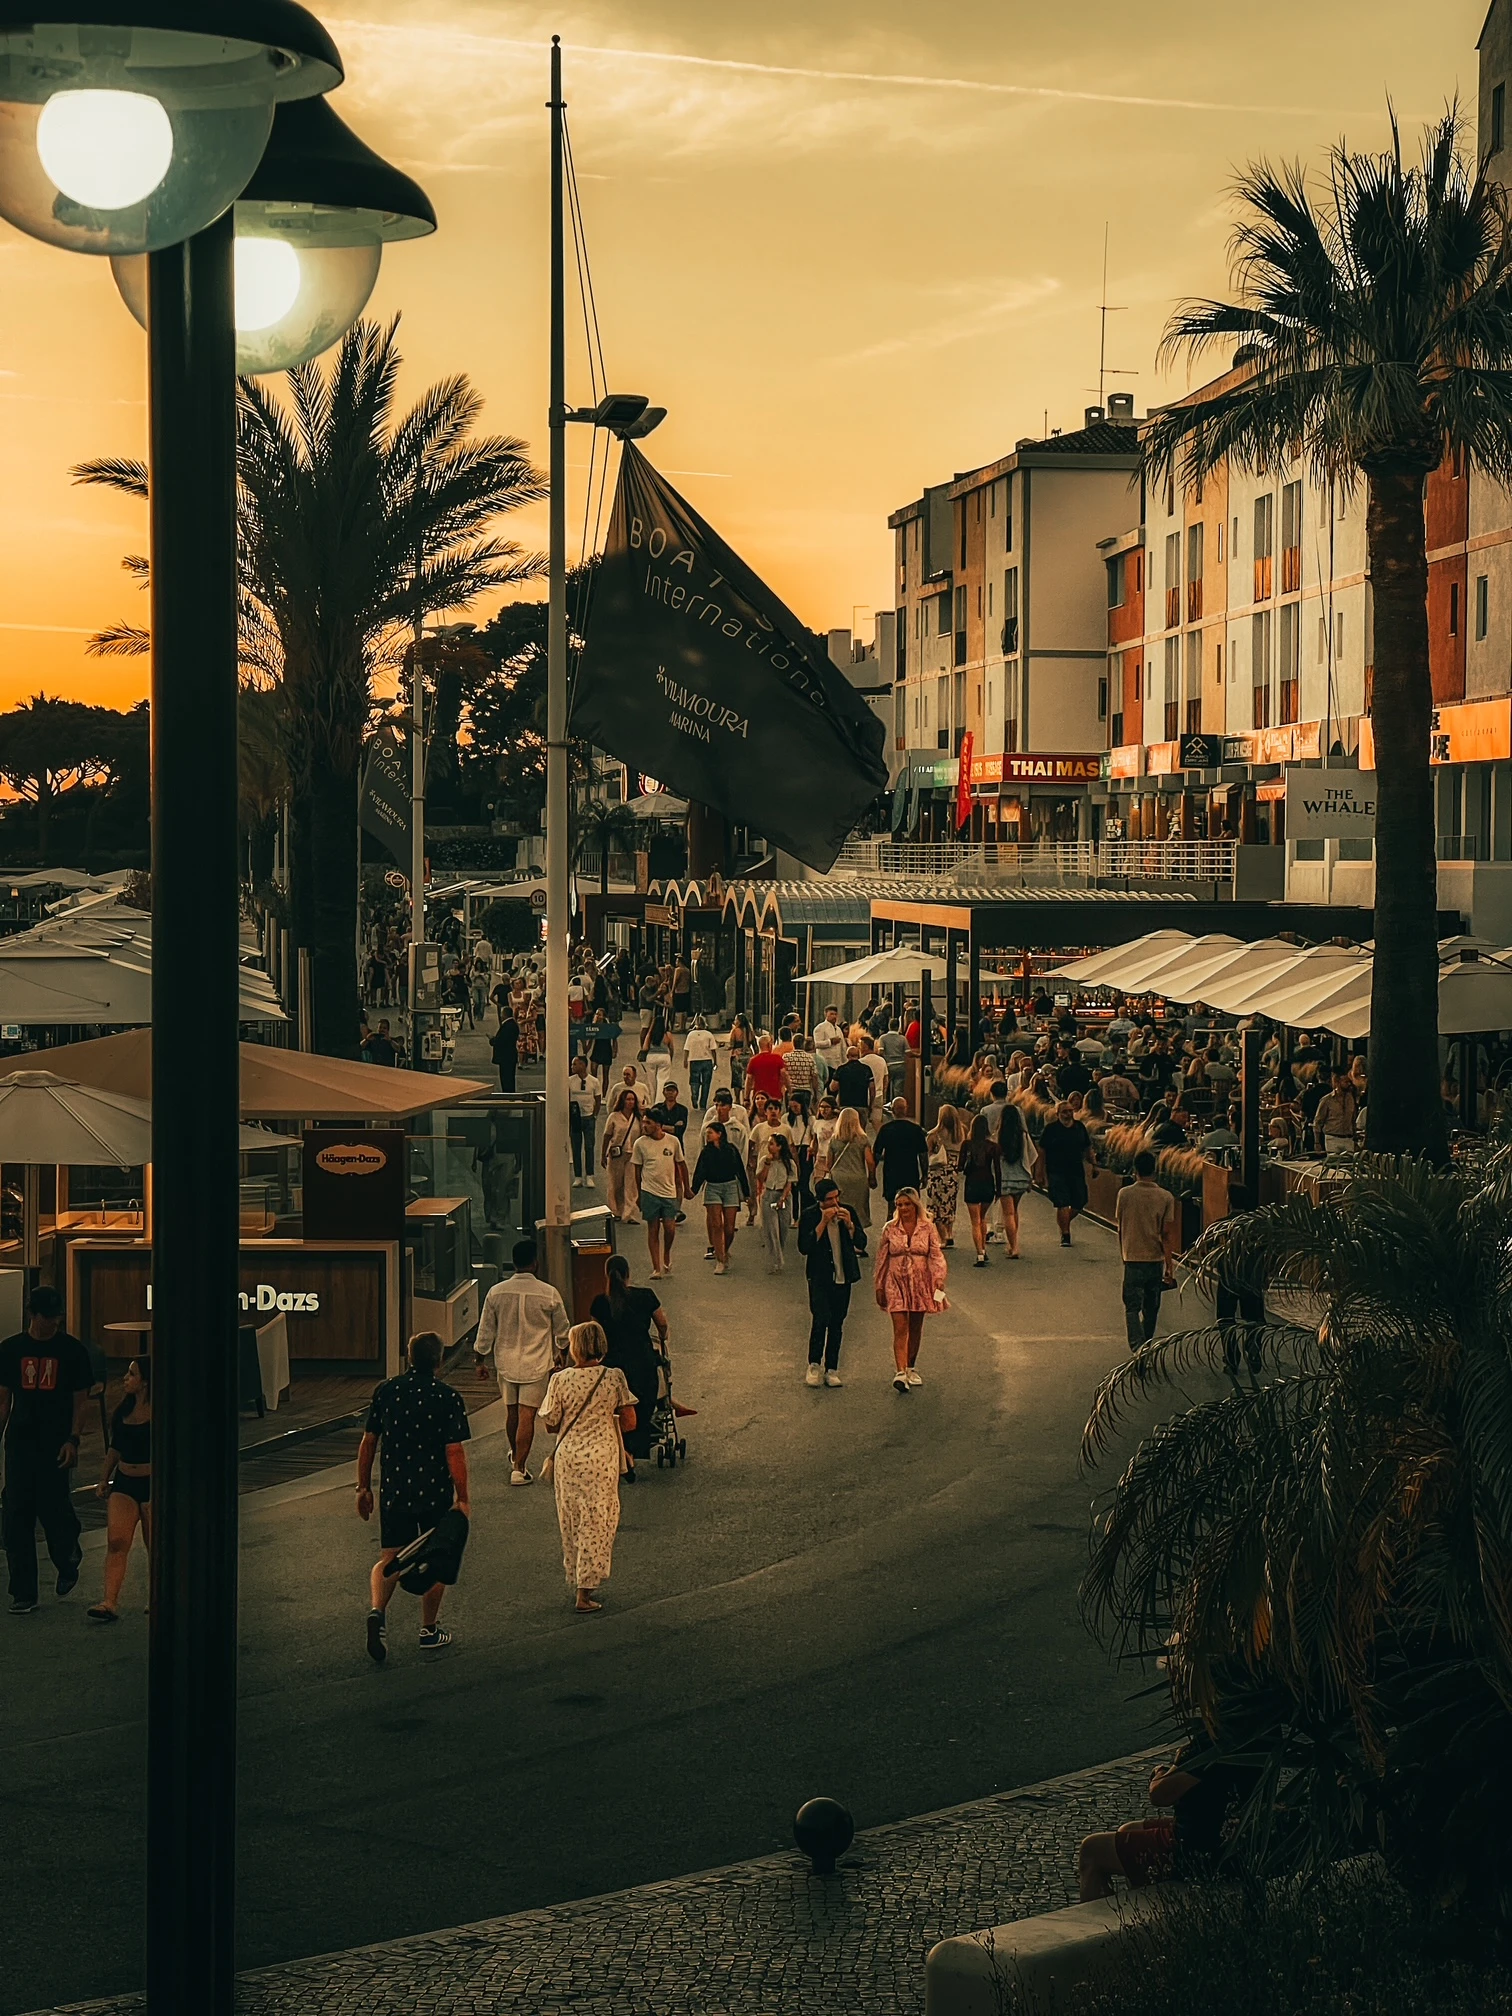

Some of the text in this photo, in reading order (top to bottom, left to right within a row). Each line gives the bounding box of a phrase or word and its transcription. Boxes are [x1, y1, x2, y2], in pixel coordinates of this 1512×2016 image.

[630, 516, 731, 588] BOAT
[664, 676, 748, 738] VILAMOURA
[669, 711, 710, 743] MARINA
[1010, 760, 1053, 777] THAI
[1324, 788, 1354, 800] THE
[1303, 800, 1376, 816] WHALE
[534, 894, 544, 903] 10
[321, 1153, 380, 1166] Häagen-Dazs
